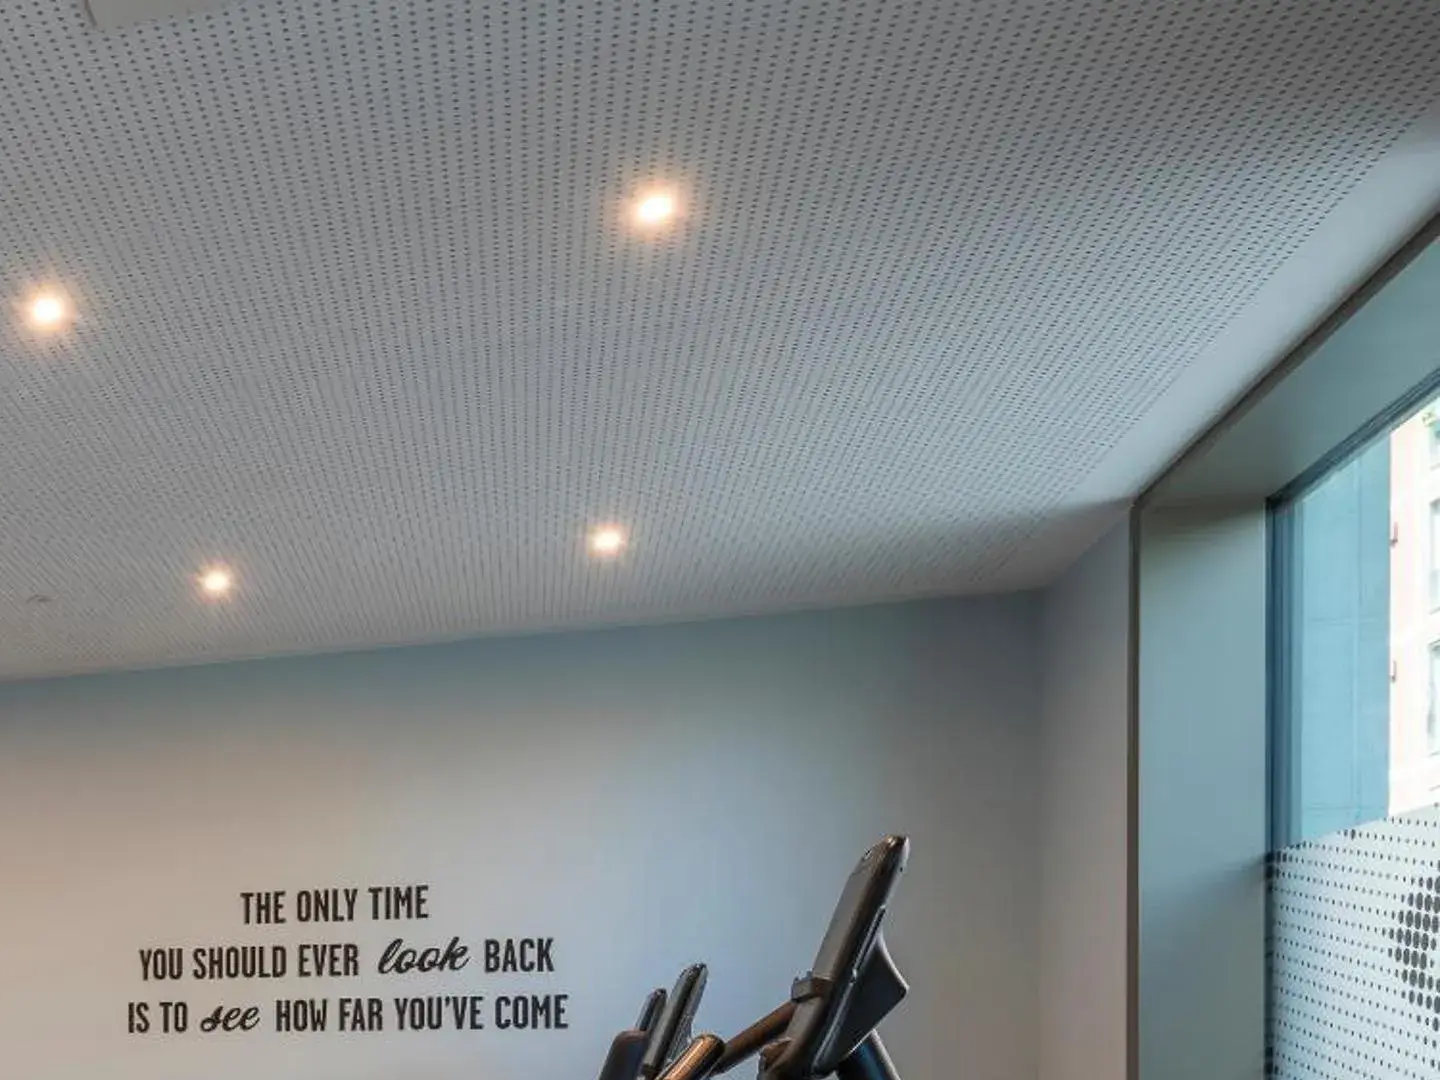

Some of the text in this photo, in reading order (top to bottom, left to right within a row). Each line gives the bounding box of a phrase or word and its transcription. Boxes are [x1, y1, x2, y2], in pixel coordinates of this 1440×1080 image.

[241, 886, 428, 924] THE ONLY TIME
[140, 937, 553, 980] YOU SHOULD EVER look BACK
[129, 995, 568, 1033] IS TO see HOW FAR YOU'VE COME
